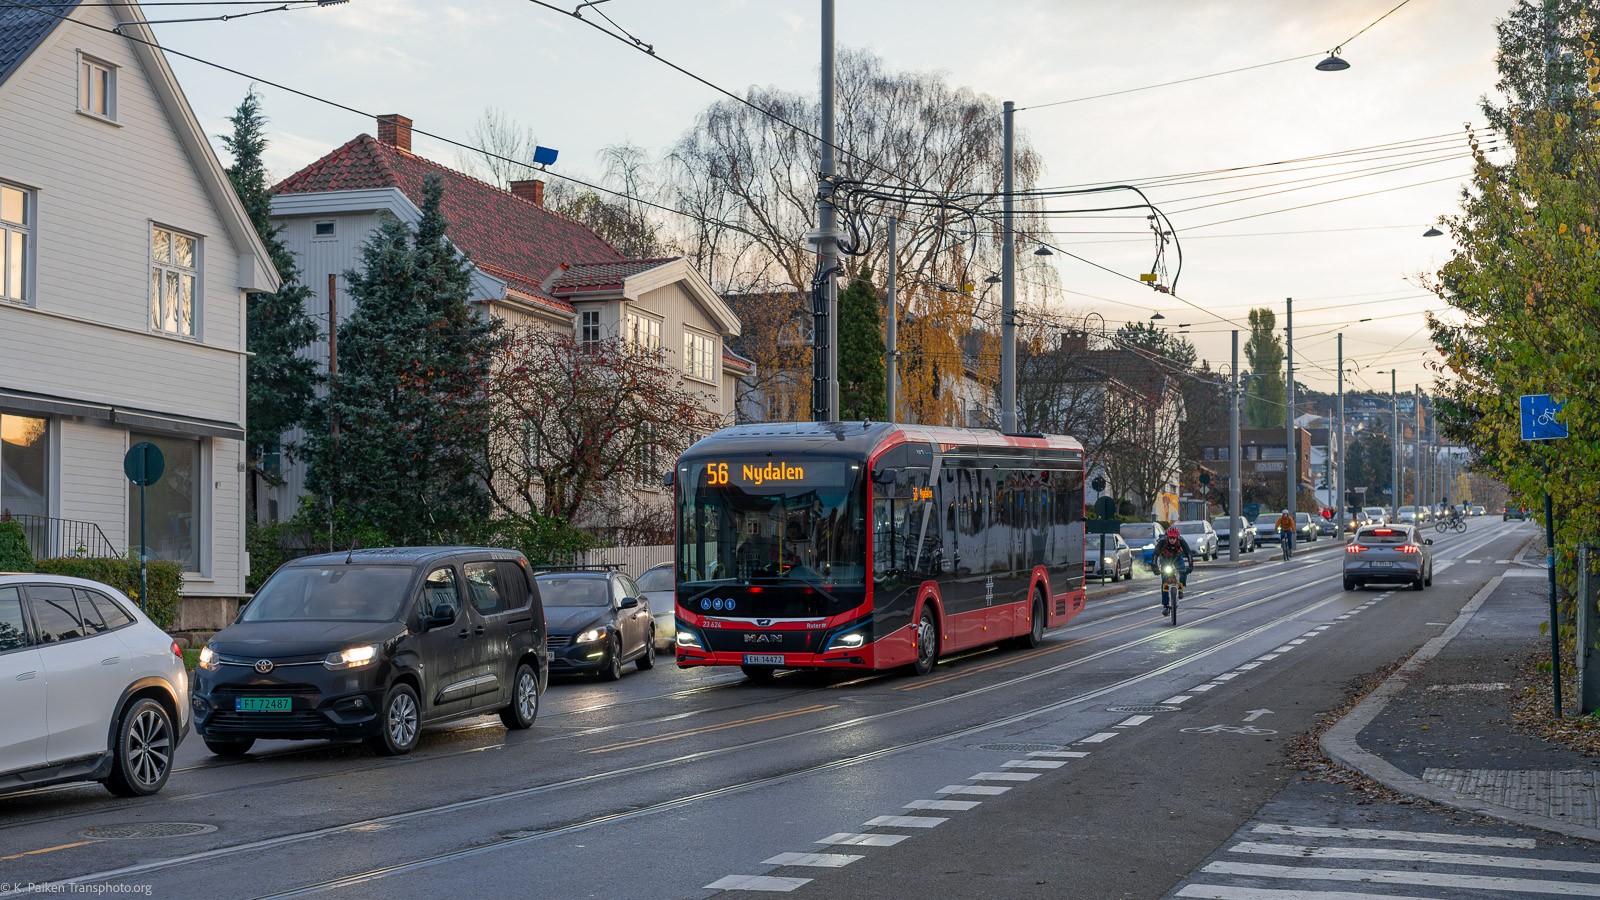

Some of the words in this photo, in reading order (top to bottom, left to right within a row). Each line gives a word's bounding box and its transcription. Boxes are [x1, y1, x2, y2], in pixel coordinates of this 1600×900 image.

[707, 462, 729, 485] 56
[743, 461, 804, 485] Nydalen
[710, 621, 722, 629] 624
[744, 633, 783, 643] MAN
[244, 699, 256, 709] FT
[259, 699, 289, 709] 72487
